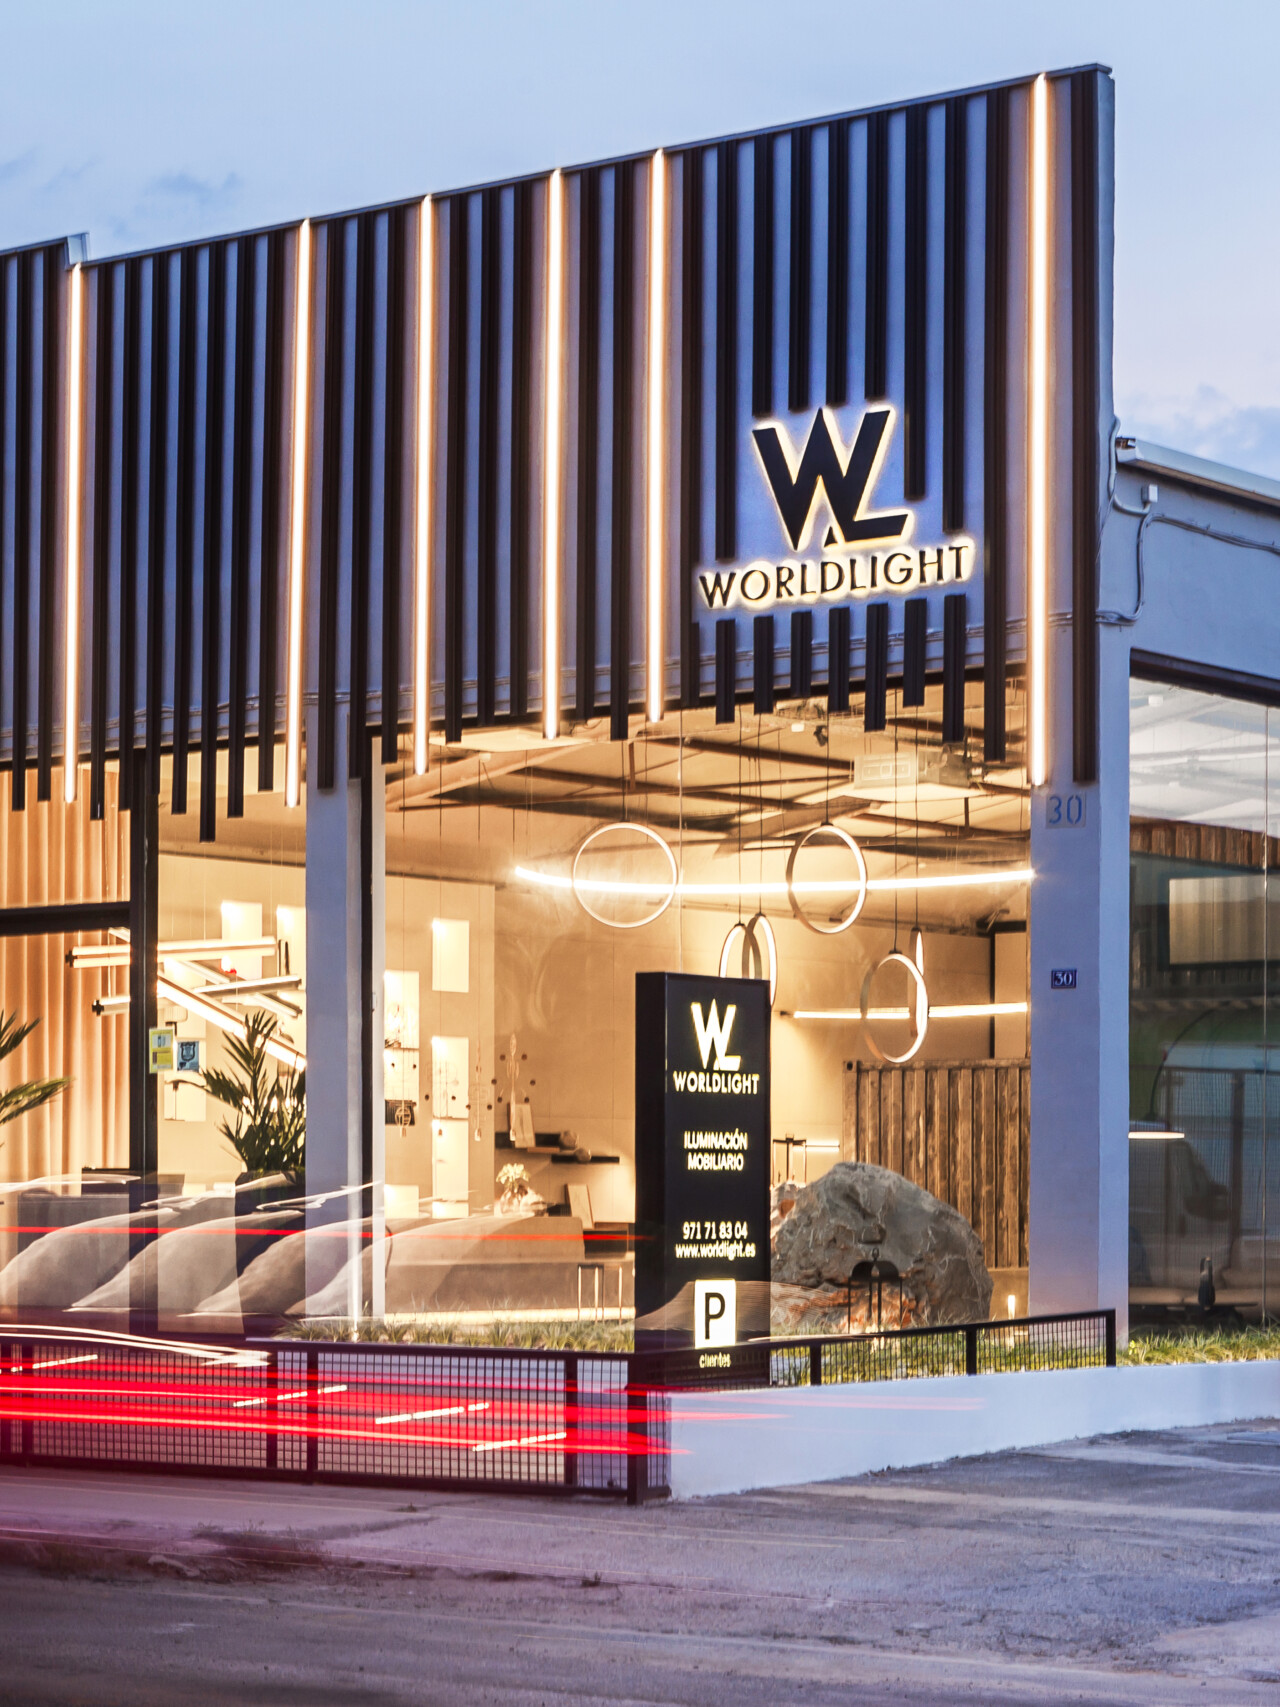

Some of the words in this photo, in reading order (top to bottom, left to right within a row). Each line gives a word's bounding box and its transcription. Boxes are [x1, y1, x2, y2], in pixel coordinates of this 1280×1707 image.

[699, 545, 968, 608] WORLDLIGHT
[1048, 795, 1083, 825] 30
[1054, 973, 1072, 986] 30
[673, 1070, 760, 1095] WORLDLIGHT
[684, 1128, 748, 1150] ILUMINACIÓN
[687, 1152, 744, 1171] MOBILIARIO
[683, 1221, 701, 1240] 971
[704, 1221, 716, 1240] 71
[719, 1221, 732, 1240] 83
[734, 1221, 748, 1240] 04
[675, 1240, 756, 1261] www.worldlight.es
[705, 1292, 726, 1340] P
